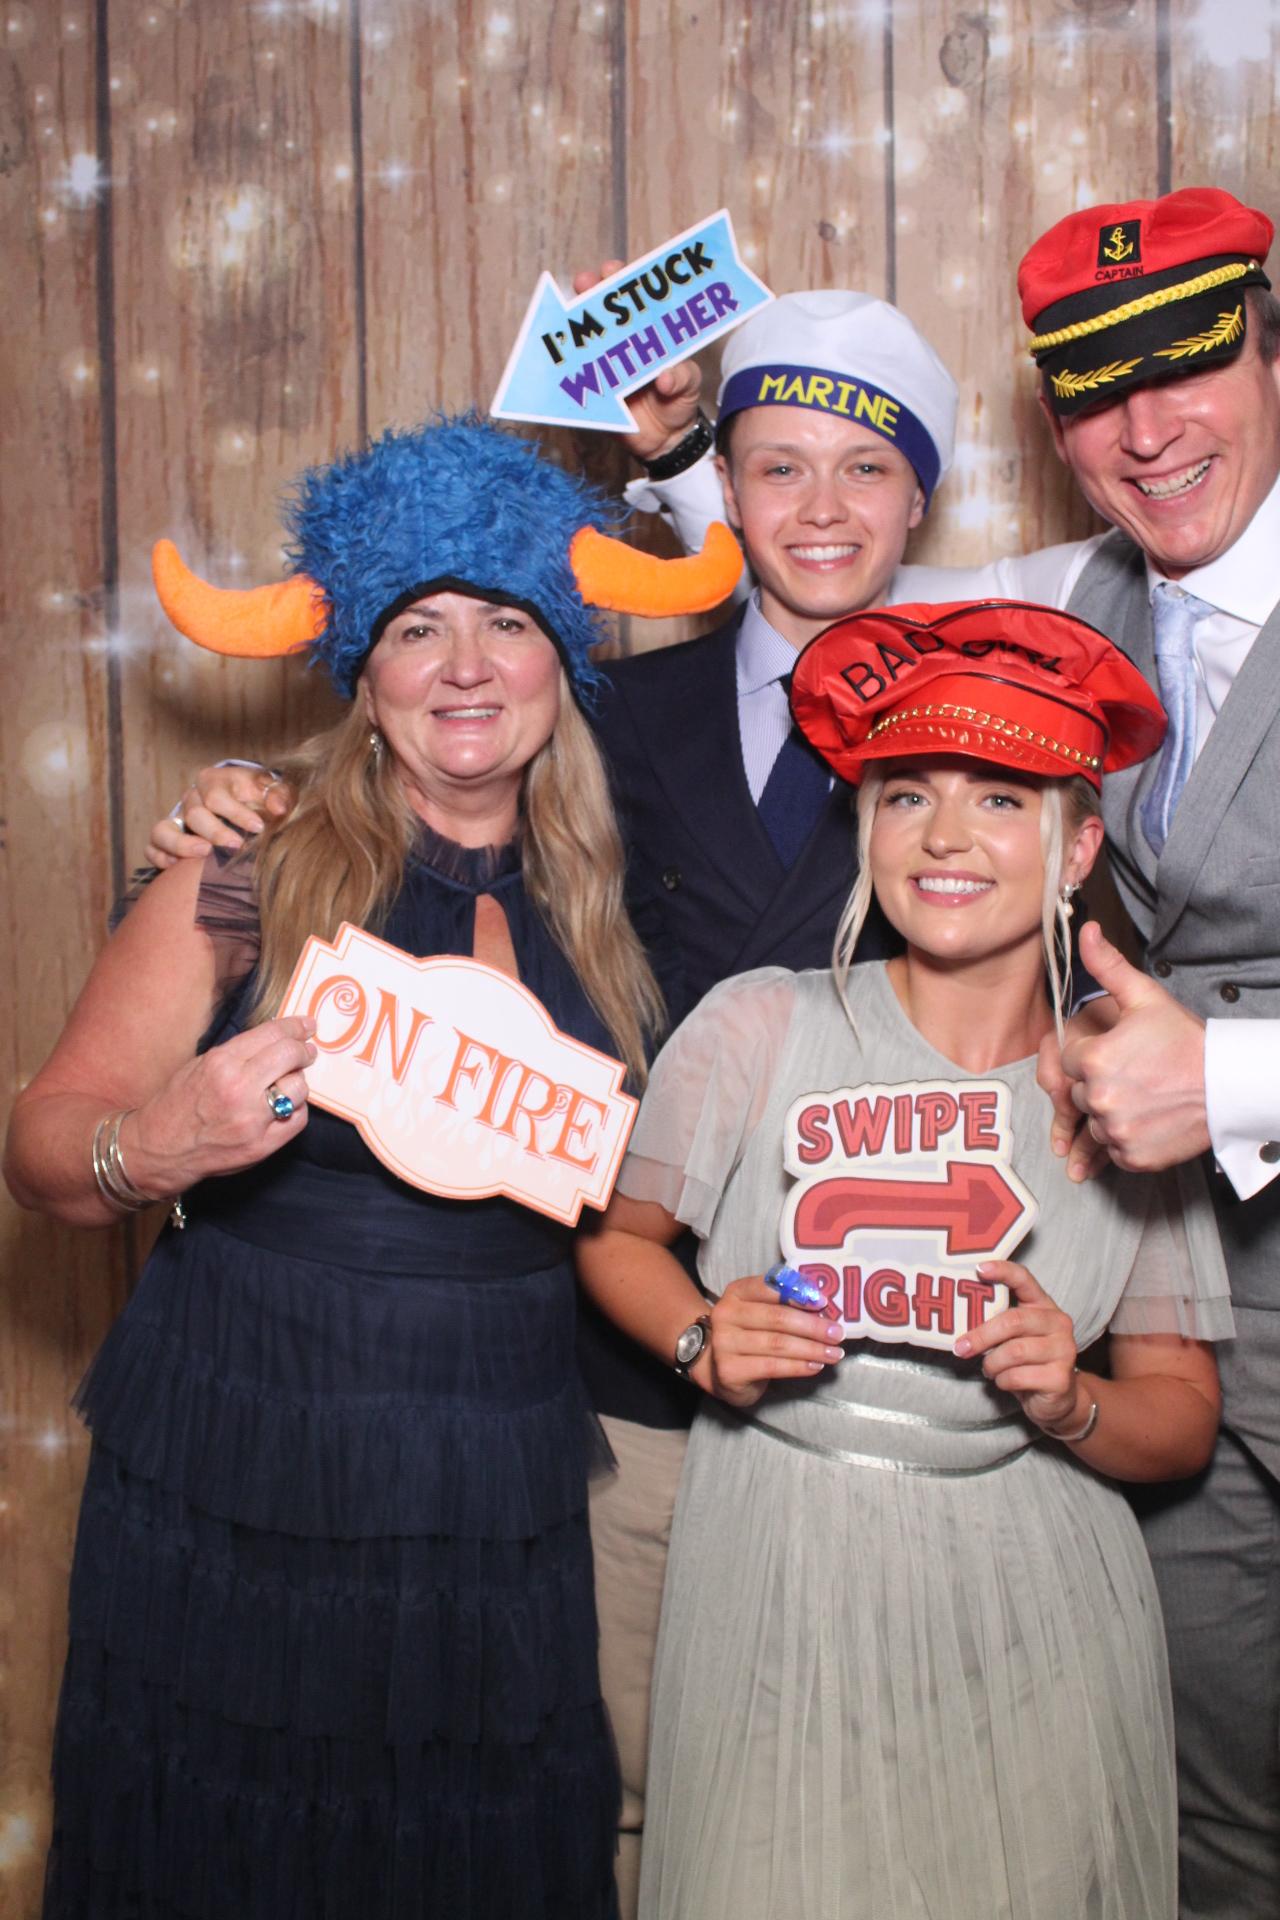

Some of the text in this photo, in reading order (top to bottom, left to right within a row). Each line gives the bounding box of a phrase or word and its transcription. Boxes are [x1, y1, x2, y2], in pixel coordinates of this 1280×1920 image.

[540, 241, 715, 366] I'M STUCK
[1094, 265, 1144, 281] CAPTAIN
[559, 280, 740, 408] WITH HER
[758, 373, 900, 437] MARINE
[839, 629, 945, 702] BAD
[307, 974, 611, 1174] ON FIRE
[797, 1091, 1000, 1164] SWIPE
[798, 1263, 995, 1335] RIGHT
